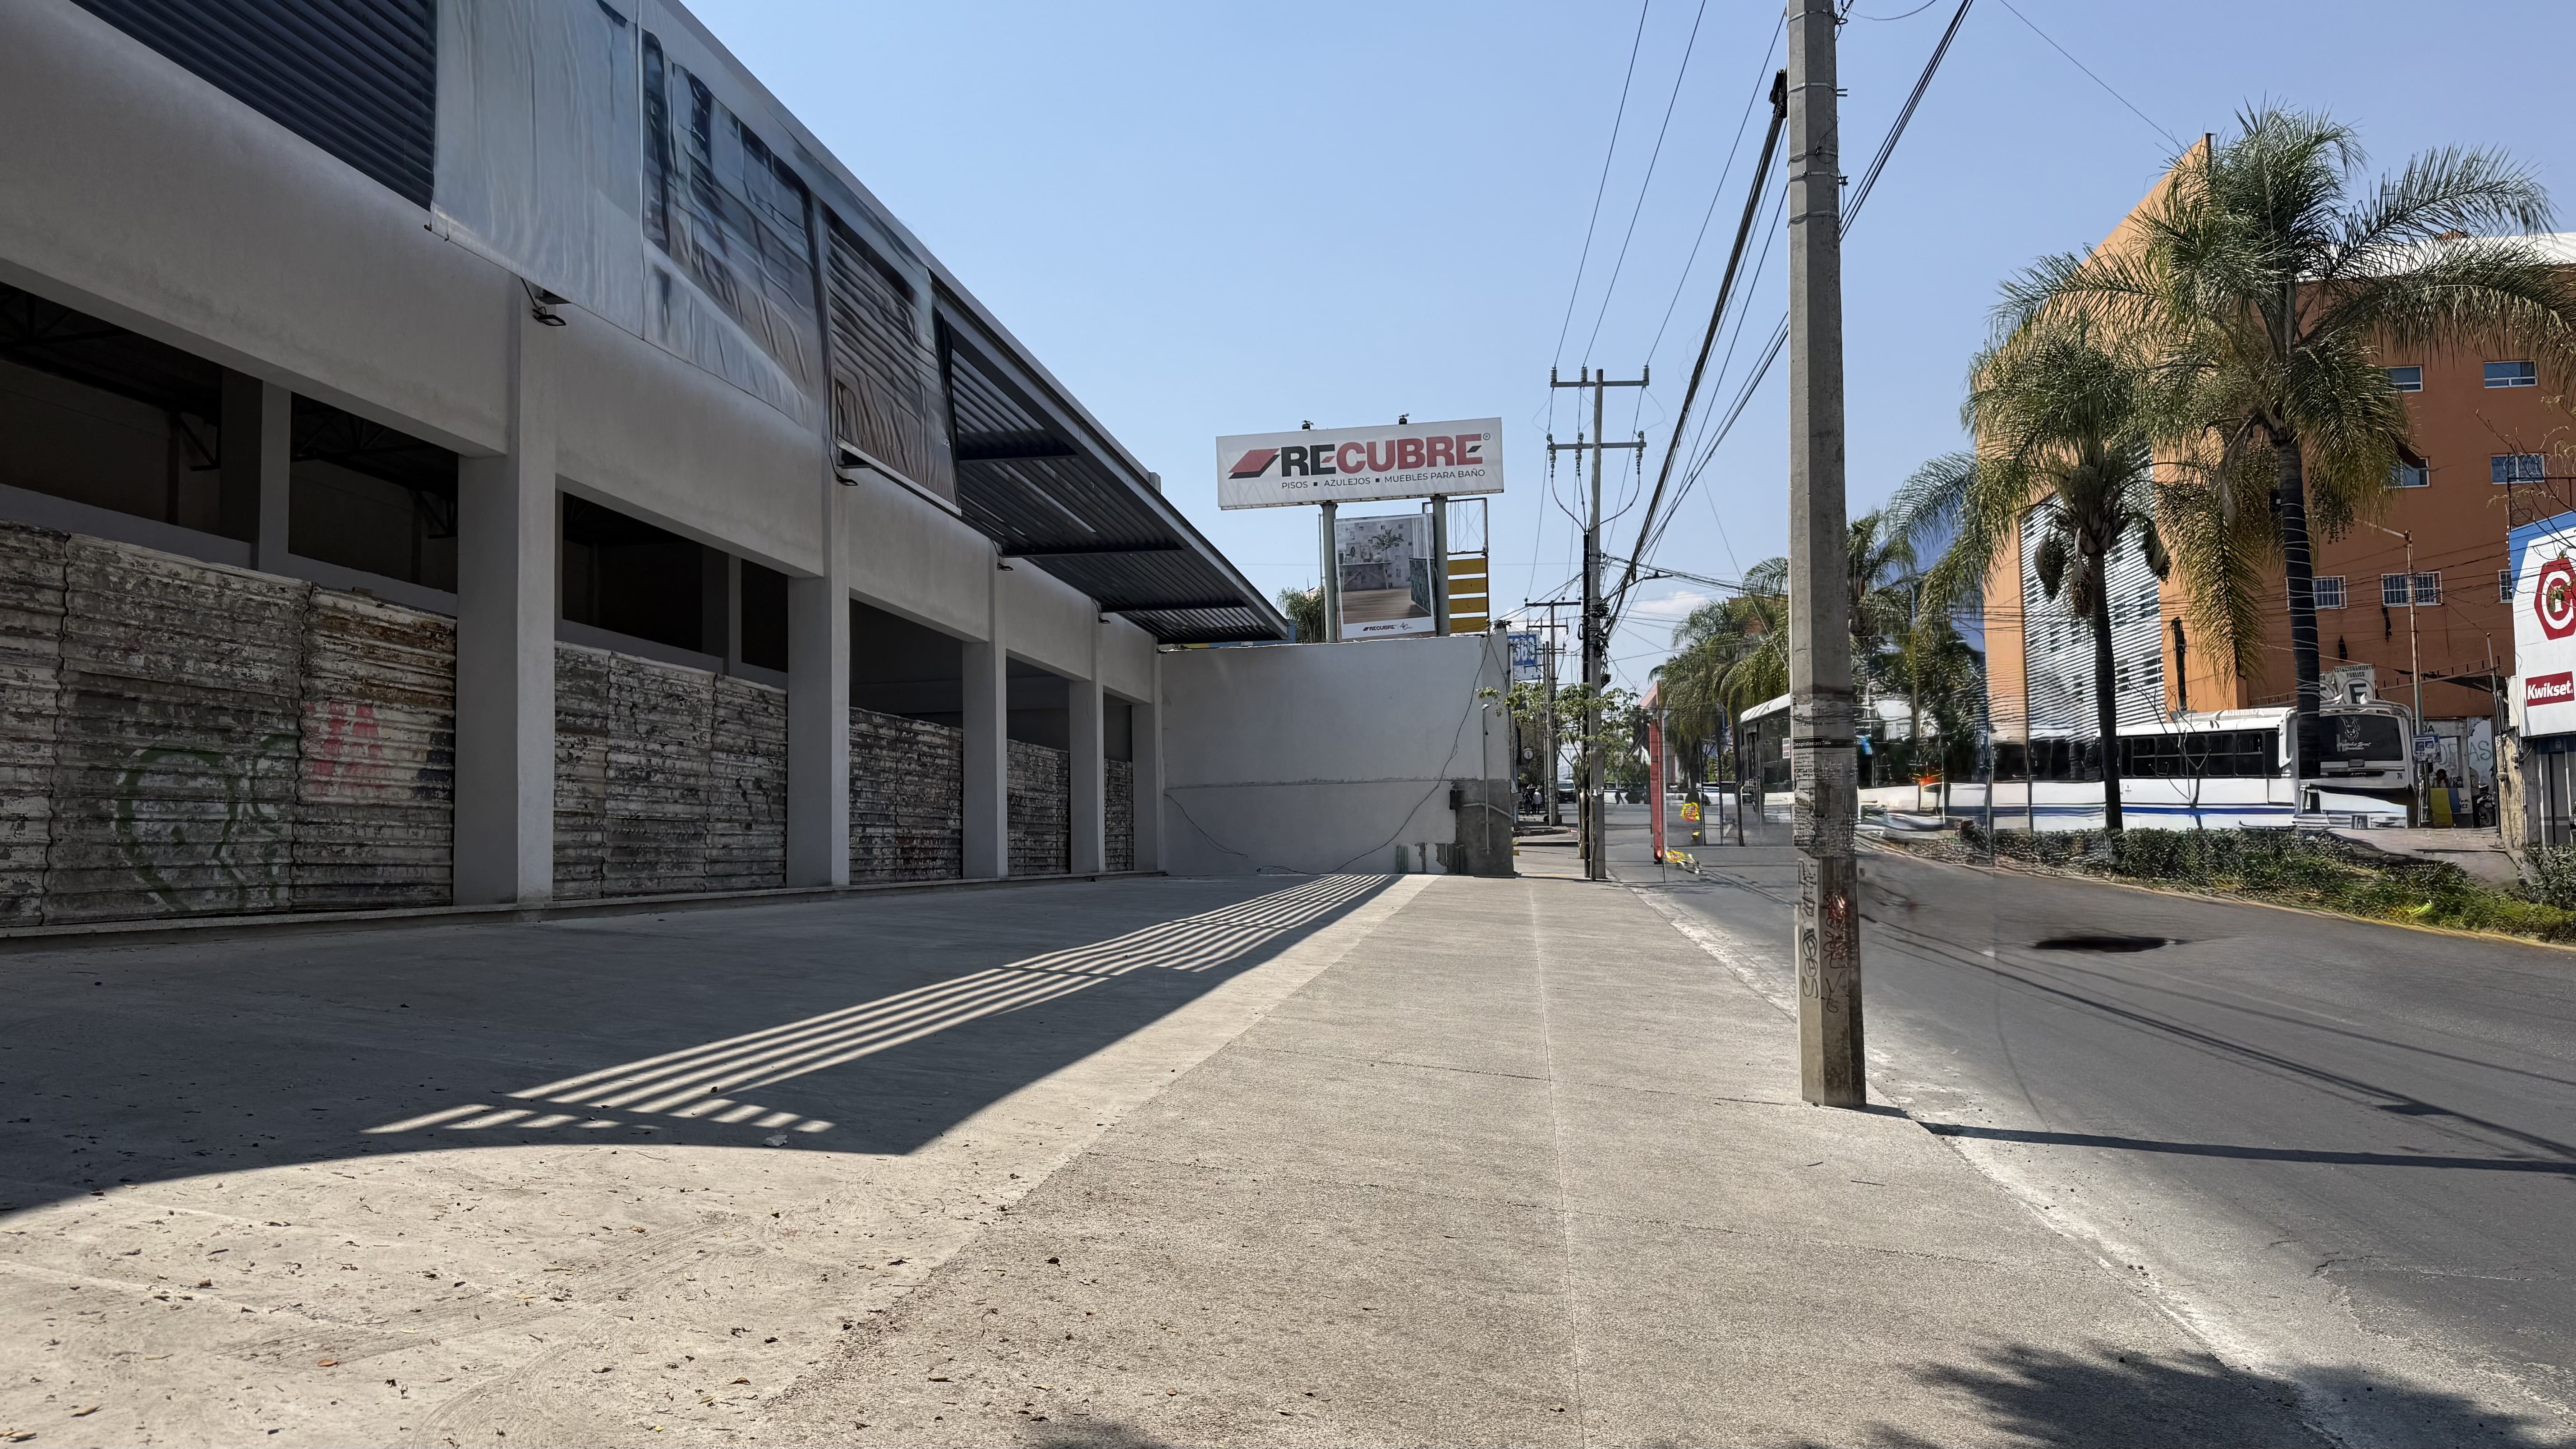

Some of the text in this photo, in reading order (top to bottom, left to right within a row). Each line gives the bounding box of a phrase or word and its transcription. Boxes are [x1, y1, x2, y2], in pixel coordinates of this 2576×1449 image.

[1281, 433, 1483, 477] RECUBRE
[1282, 468, 1486, 489] PISOS AZULEJOS MUEBLES PARA BAÑO
